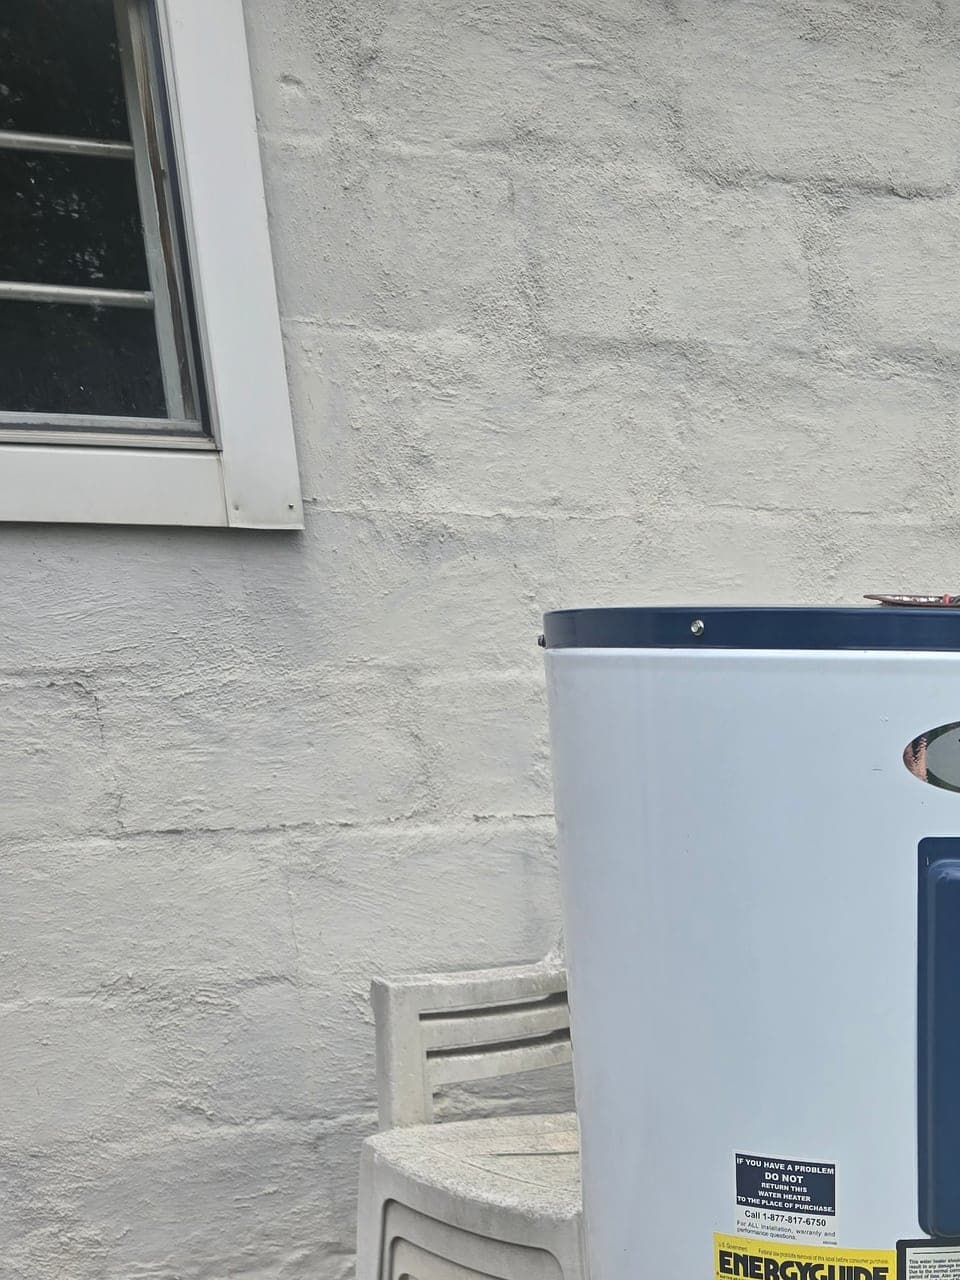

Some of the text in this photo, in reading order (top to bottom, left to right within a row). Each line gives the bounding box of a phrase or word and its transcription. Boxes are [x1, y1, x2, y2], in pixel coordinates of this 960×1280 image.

[736, 1157, 744, 1165] IF
[745, 1159, 762, 1167] YOU
[763, 1161, 785, 1170] HAVE
[794, 1165, 834, 1175] PROBLEM
[764, 1172, 804, 1184] DO NOT
[761, 1182, 808, 1193] RETURN THIS
[758, 1190, 811, 1202] WATER HEATER
[747, 1197, 761, 1205] THE
[762, 1199, 783, 1208] PLACE
[794, 1203, 835, 1213] PURCHASE.
[744, 1210, 827, 1227] Call 1-877-817-6750
